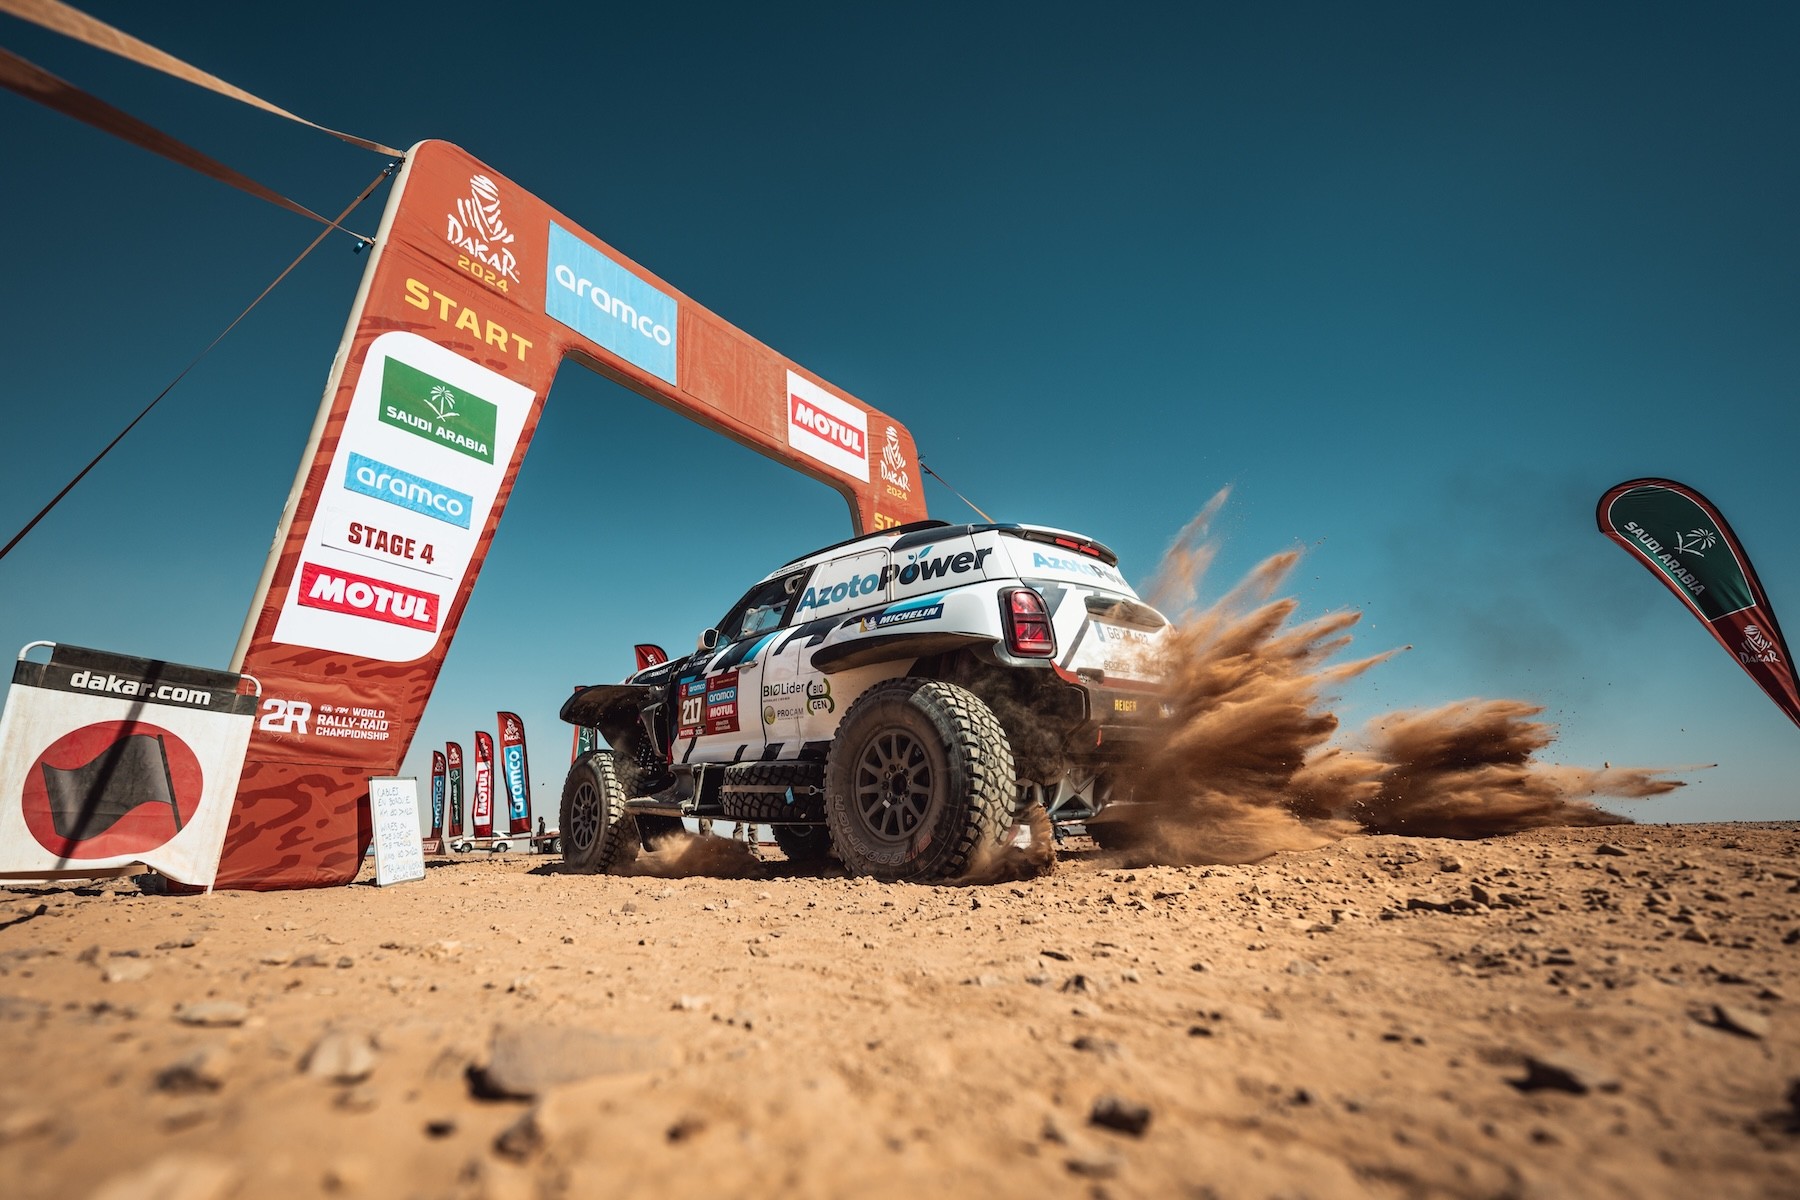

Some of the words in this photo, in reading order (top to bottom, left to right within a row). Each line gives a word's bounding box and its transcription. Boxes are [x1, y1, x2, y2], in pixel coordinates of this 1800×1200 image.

[447, 214, 519, 283] DAKAR
[458, 255, 509, 293] 2024
[404, 277, 533, 361] START
[555, 264, 671, 346] aramco
[387, 405, 432, 433] SAUDI
[435, 426, 488, 456] ARABIA
[795, 402, 862, 453] MOTUL
[356, 466, 463, 516] aramco
[880, 460, 911, 492] DAKAR
[886, 484, 907, 501] 2024
[874, 512, 902, 530] STA
[347, 522, 416, 560] STAGE
[420, 543, 434, 565] 4
[1624, 521, 1663, 553] SAUDI
[1659, 549, 1705, 596] ARABIA
[308, 573, 430, 623] MOTUL
[797, 547, 993, 613] AzotoPower
[878, 607, 939, 625] MICHELIN
[1739, 650, 1780, 664] DAKAR
[70, 671, 211, 705] dakar.com
[689, 684, 705, 692] aramco
[709, 691, 734, 702] aramco
[812, 684, 823, 694] BIO
[813, 700, 828, 710] GEN
[260, 699, 312, 734] 2R
[353, 708, 385, 718] WORLD
[317, 714, 389, 730] RALLY-RAID
[683, 697, 702, 725] 217
[710, 705, 733, 717] MOTUL
[316, 727, 389, 740] CHAMPIONSHIP
[478, 770, 488, 814] MOTUL
[510, 750, 523, 813] aramco
[434, 780, 442, 824] aramco
